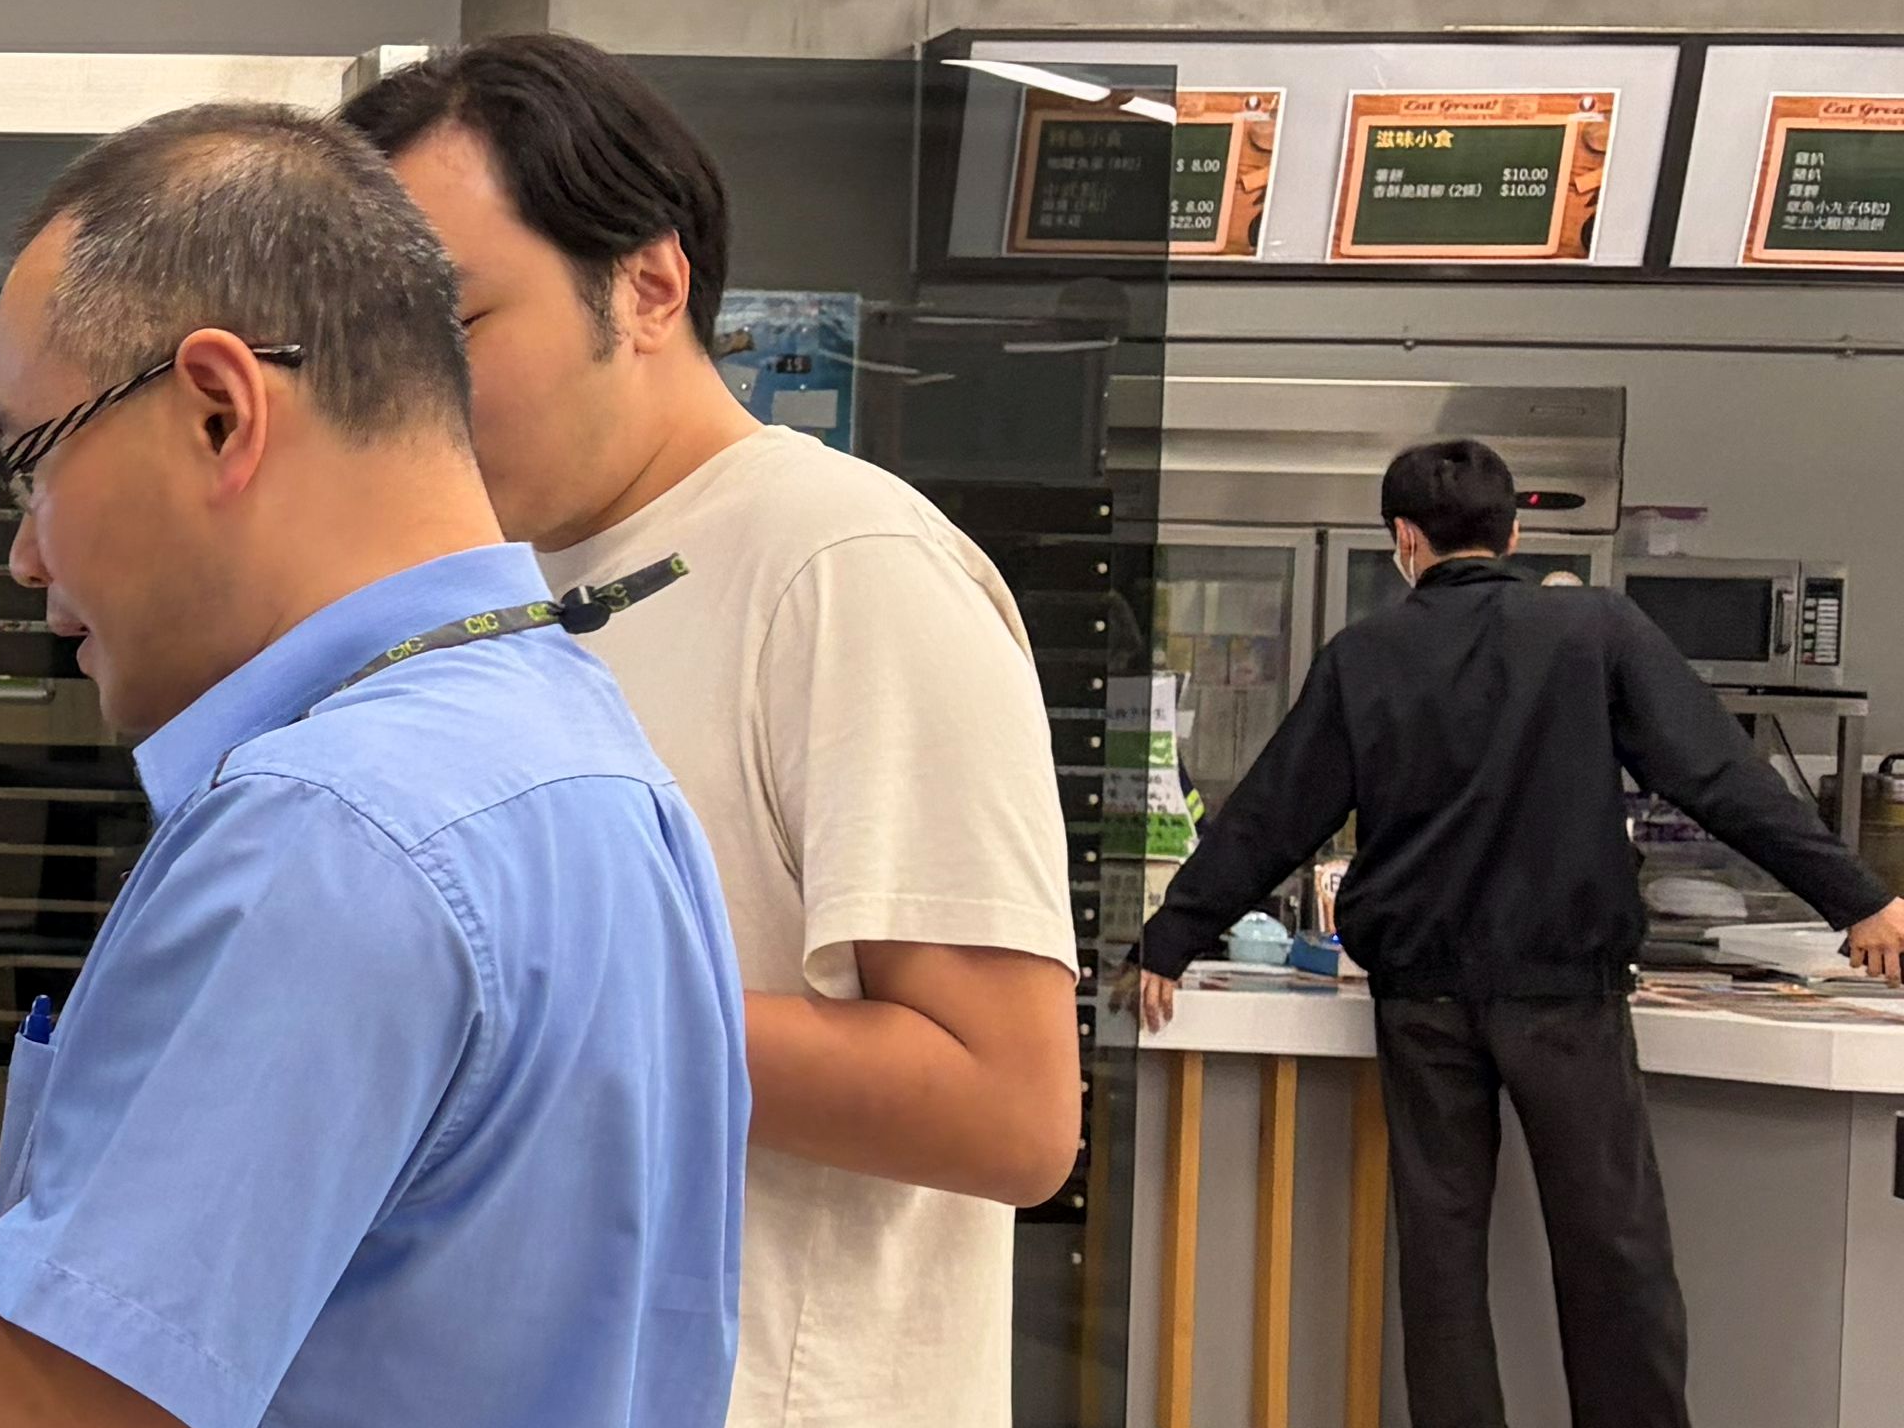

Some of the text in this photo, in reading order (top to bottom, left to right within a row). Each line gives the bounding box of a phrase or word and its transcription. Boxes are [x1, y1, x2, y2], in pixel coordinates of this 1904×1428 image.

[1374, 130, 1455, 149] 滋味小食
[1502, 169, 1549, 182] $10.00
[1499, 184, 1546, 197] $10.00
